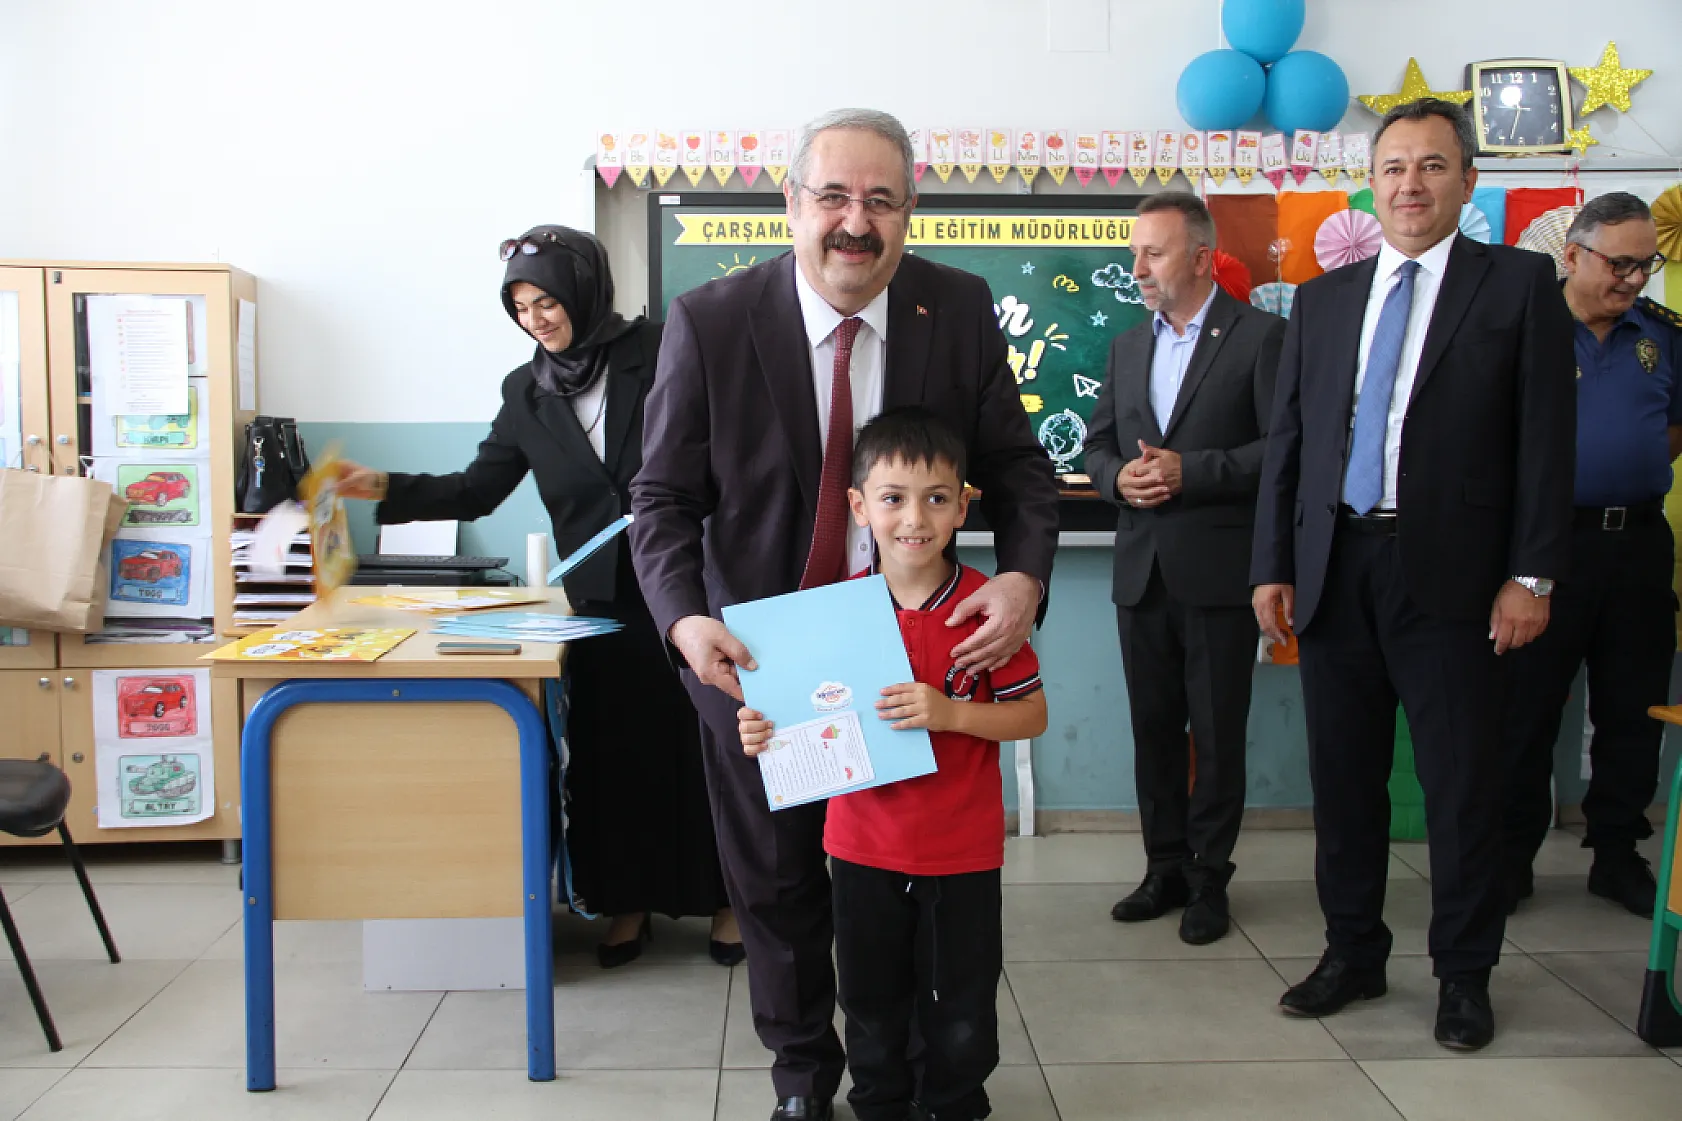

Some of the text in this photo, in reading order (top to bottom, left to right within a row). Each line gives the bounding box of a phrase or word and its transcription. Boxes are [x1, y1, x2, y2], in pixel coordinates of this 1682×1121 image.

[1491, 73, 1502, 84] 11
[1509, 72, 1523, 84] 12
[702, 221, 794, 242] ÇARŞAMB
[935, 219, 1000, 239] EĞİTİM
[1012, 219, 1130, 240] MÜDÜRLÜĞÜ
